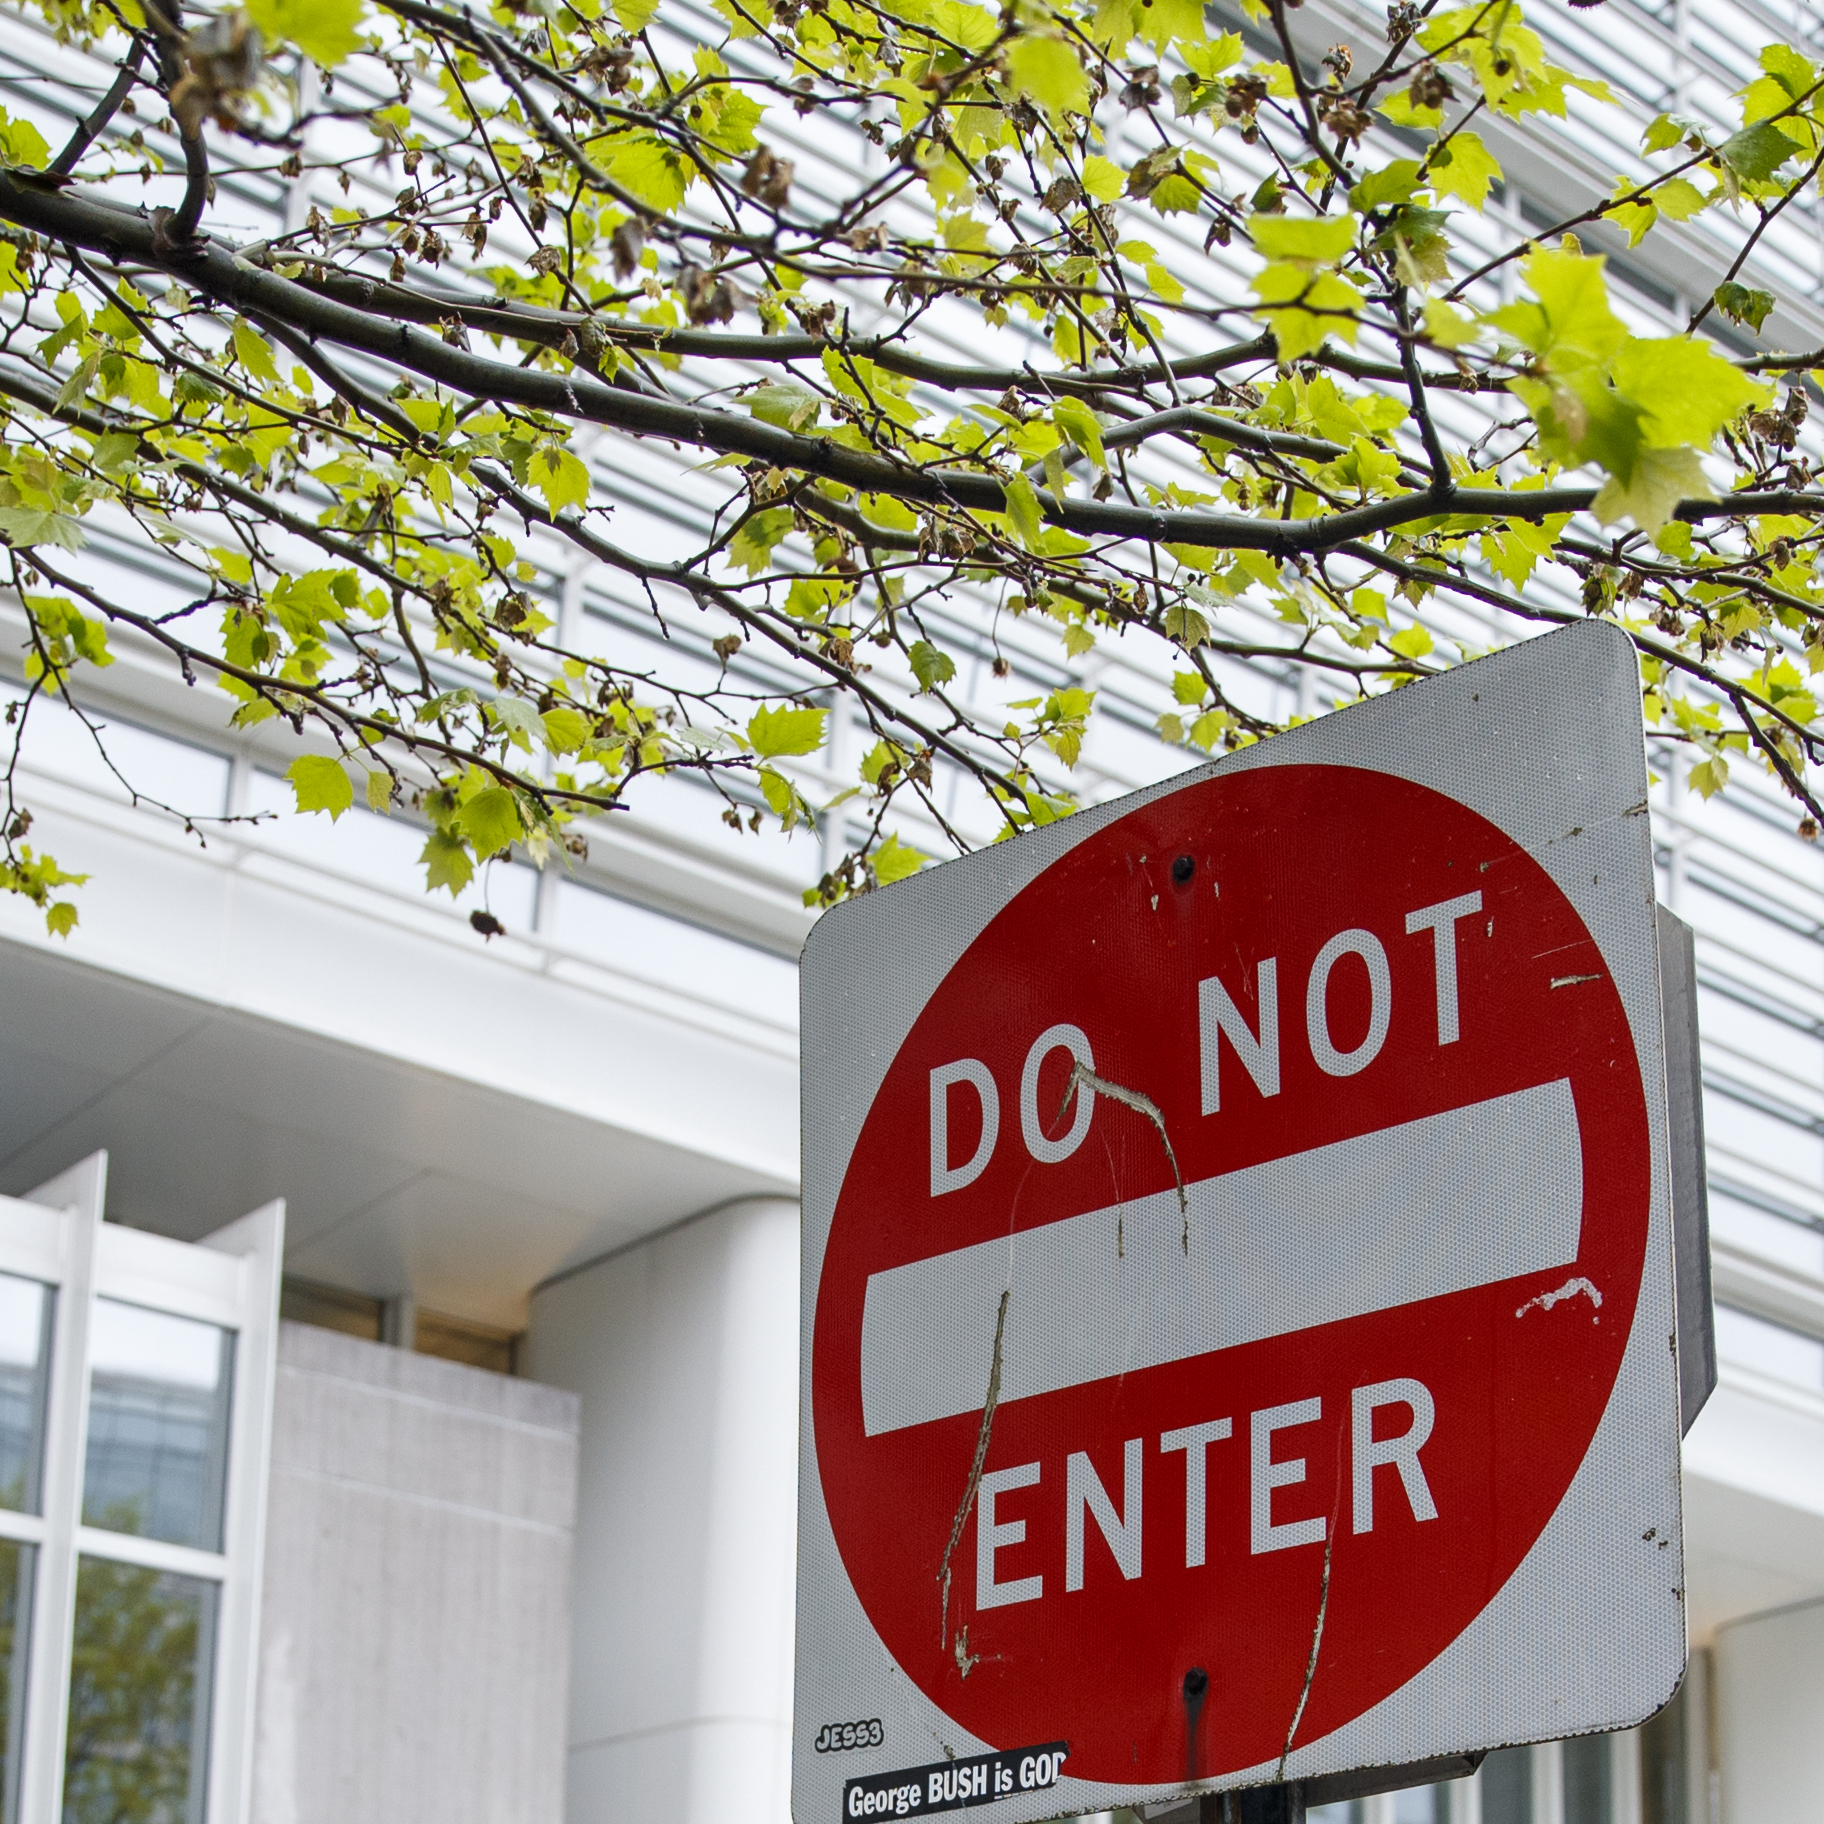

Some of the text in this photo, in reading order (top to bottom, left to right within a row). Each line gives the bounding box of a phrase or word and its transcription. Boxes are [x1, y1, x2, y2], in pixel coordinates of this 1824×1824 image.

[929, 889, 1484, 1198] DO NOT
[975, 1377, 1440, 1612] ENTER
[816, 1719, 883, 1753] JESS3
[848, 1784, 921, 1817] George
[928, 1764, 987, 1803] BUSH
[993, 1761, 1014, 1793] is
